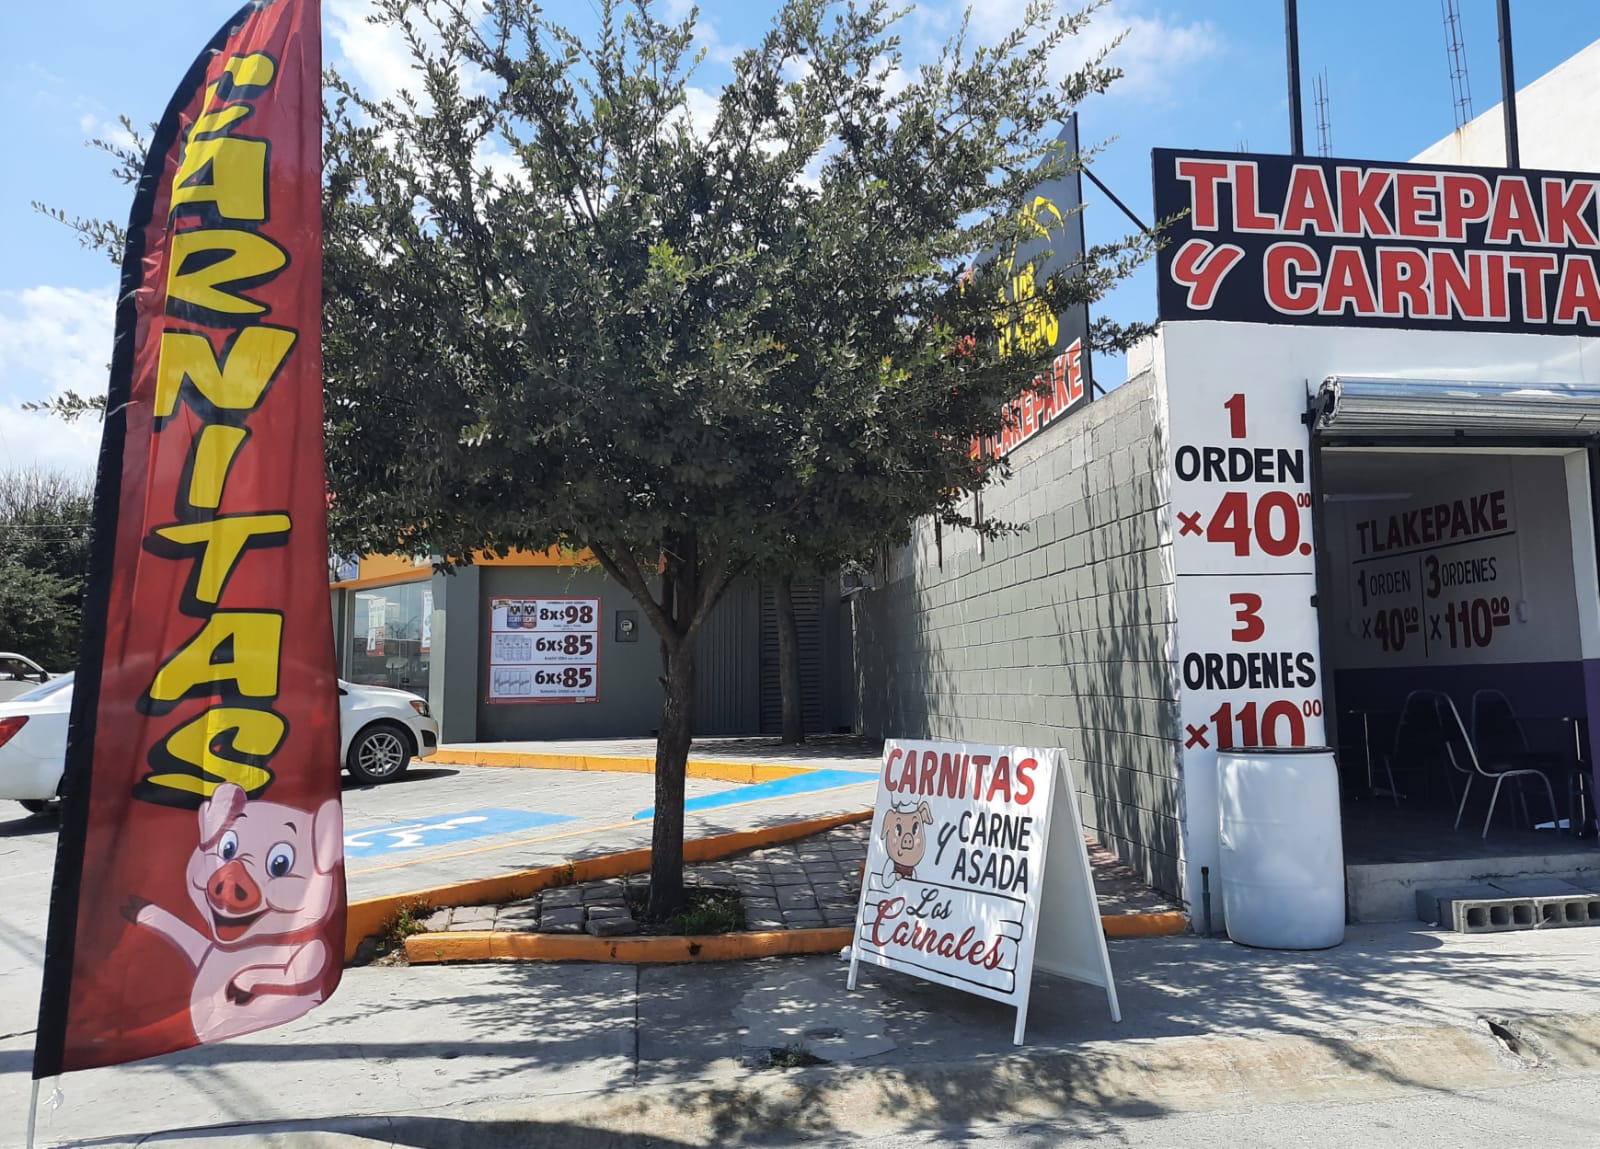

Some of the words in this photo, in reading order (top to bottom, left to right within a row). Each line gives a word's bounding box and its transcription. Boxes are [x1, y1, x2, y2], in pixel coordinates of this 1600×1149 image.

[1174, 157, 1600, 250] TLAKEPAK
[1262, 241, 1600, 327] CARNITA
[137, 50, 298, 801] CARNITAS
[1223, 393, 1247, 439] 1
[1174, 445, 1305, 484] ORDEN
[1356, 490, 1508, 555] TLAKEPAKE
[1357, 569, 1368, 607] 1
[1369, 571, 1412, 597] ORDEN
[1425, 554, 1442, 599] 3
[1441, 556, 1498, 587] ORDENES
[1229, 592, 1266, 643] 3
[1183, 651, 1317, 690] ORDENES
[884, 748, 1039, 806] CARNITAS
[958, 810, 1033, 852] CARNE
[951, 848, 1029, 894] ASADA
[905, 888, 953, 920] Los
[871, 896, 1005, 971] Carnales
